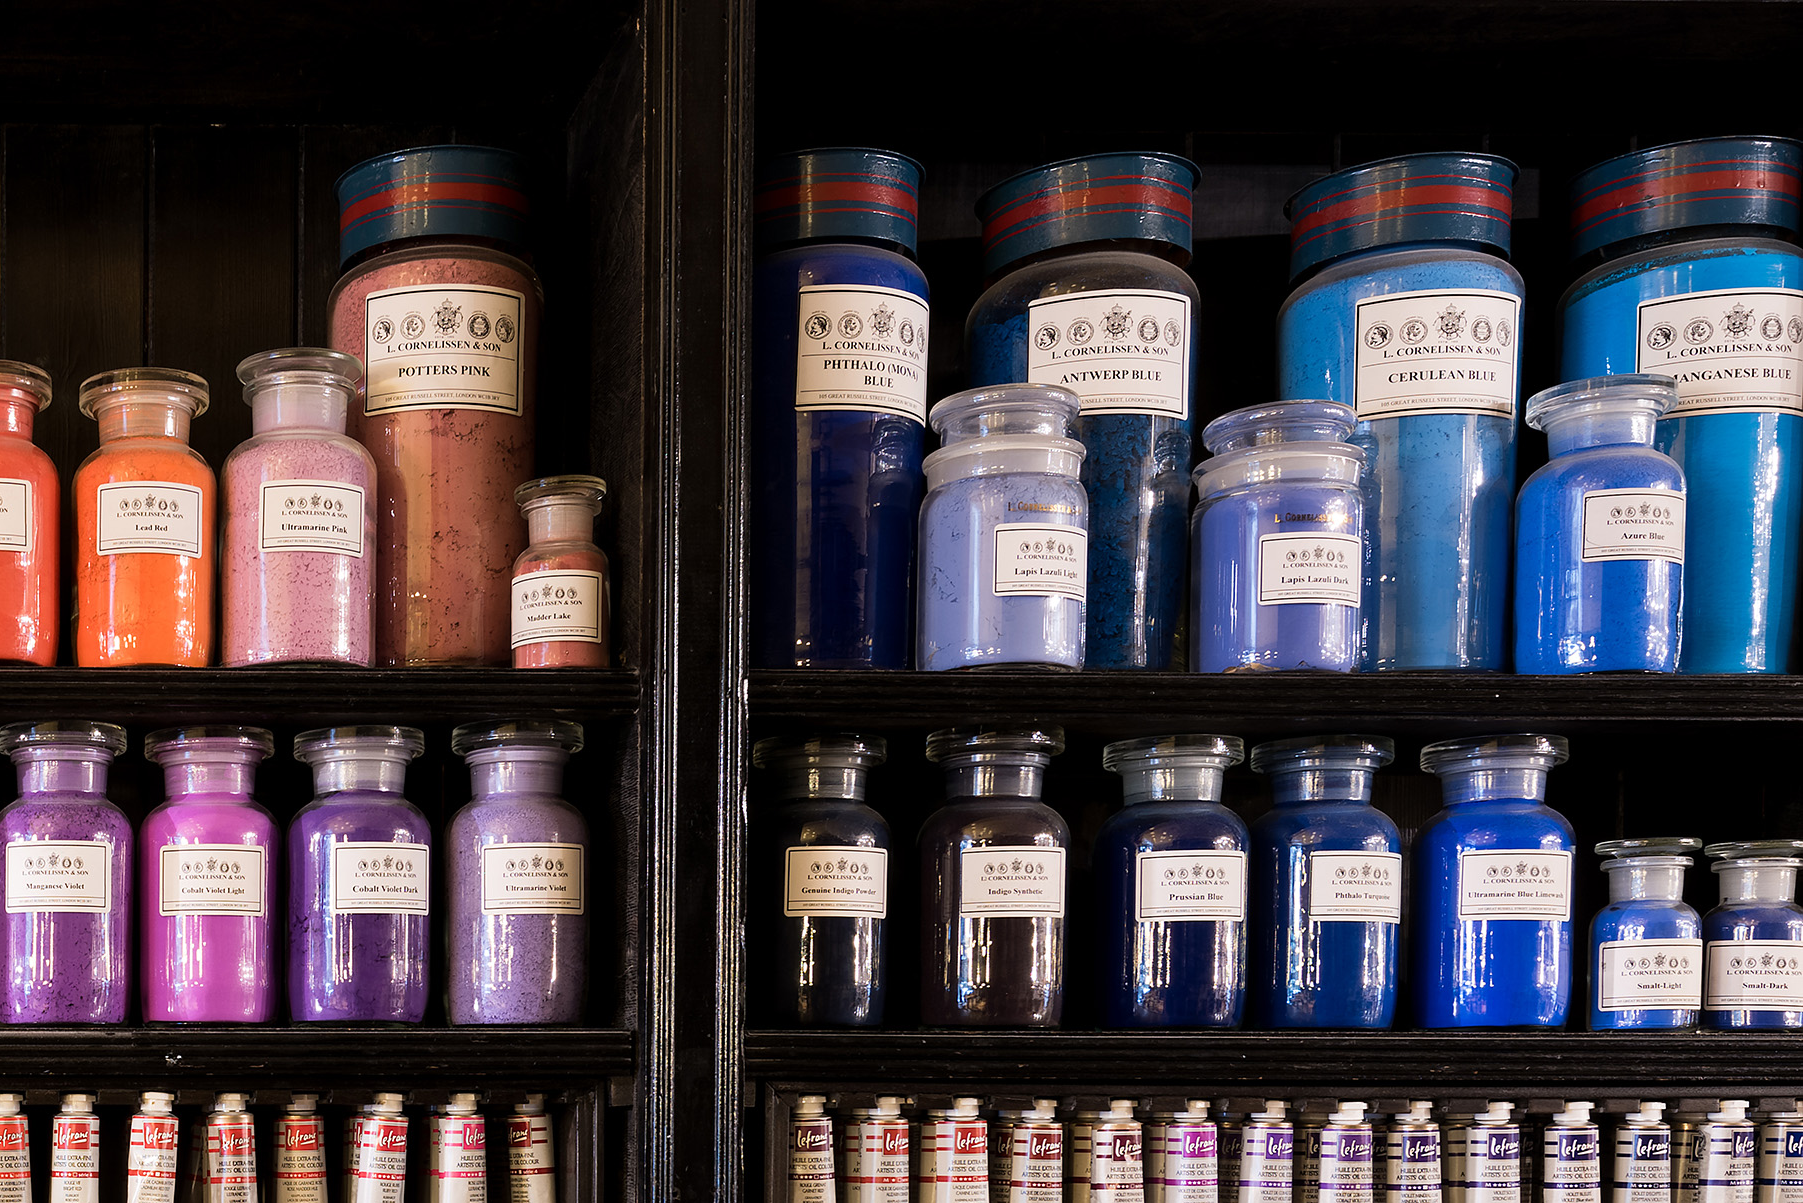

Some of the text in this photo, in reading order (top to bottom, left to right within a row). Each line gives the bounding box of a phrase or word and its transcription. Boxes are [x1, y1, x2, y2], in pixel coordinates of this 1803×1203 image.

[387, 340, 501, 353] L. CORNELISSEN & SON
[1384, 346, 1501, 358] L. CORNELISSEN & SON
[399, 366, 490, 377] POTTERS PINK
[824, 359, 919, 382] PHTHALO (MONA)
[1763, 368, 1791, 379] BLUE
[865, 376, 894, 388] BLUE
[1060, 370, 1162, 383] ANTWERP BLUE
[1389, 370, 1497, 384] CERULEAN BLUE
[281, 524, 348, 534] Ultramarine Pink
[1621, 532, 1665, 540] Azure Blue
[1014, 568, 1078, 579] Lapis Lazuli Light
[1282, 576, 1305, 586] Lapis
[1333, 576, 1348, 585] Dark
[527, 615, 552, 623] Madder
[227, 887, 245, 895] Light
[988, 888, 1043, 896] Indigo Synthetic
[1742, 982, 1789, 990] Smalt-Dark
